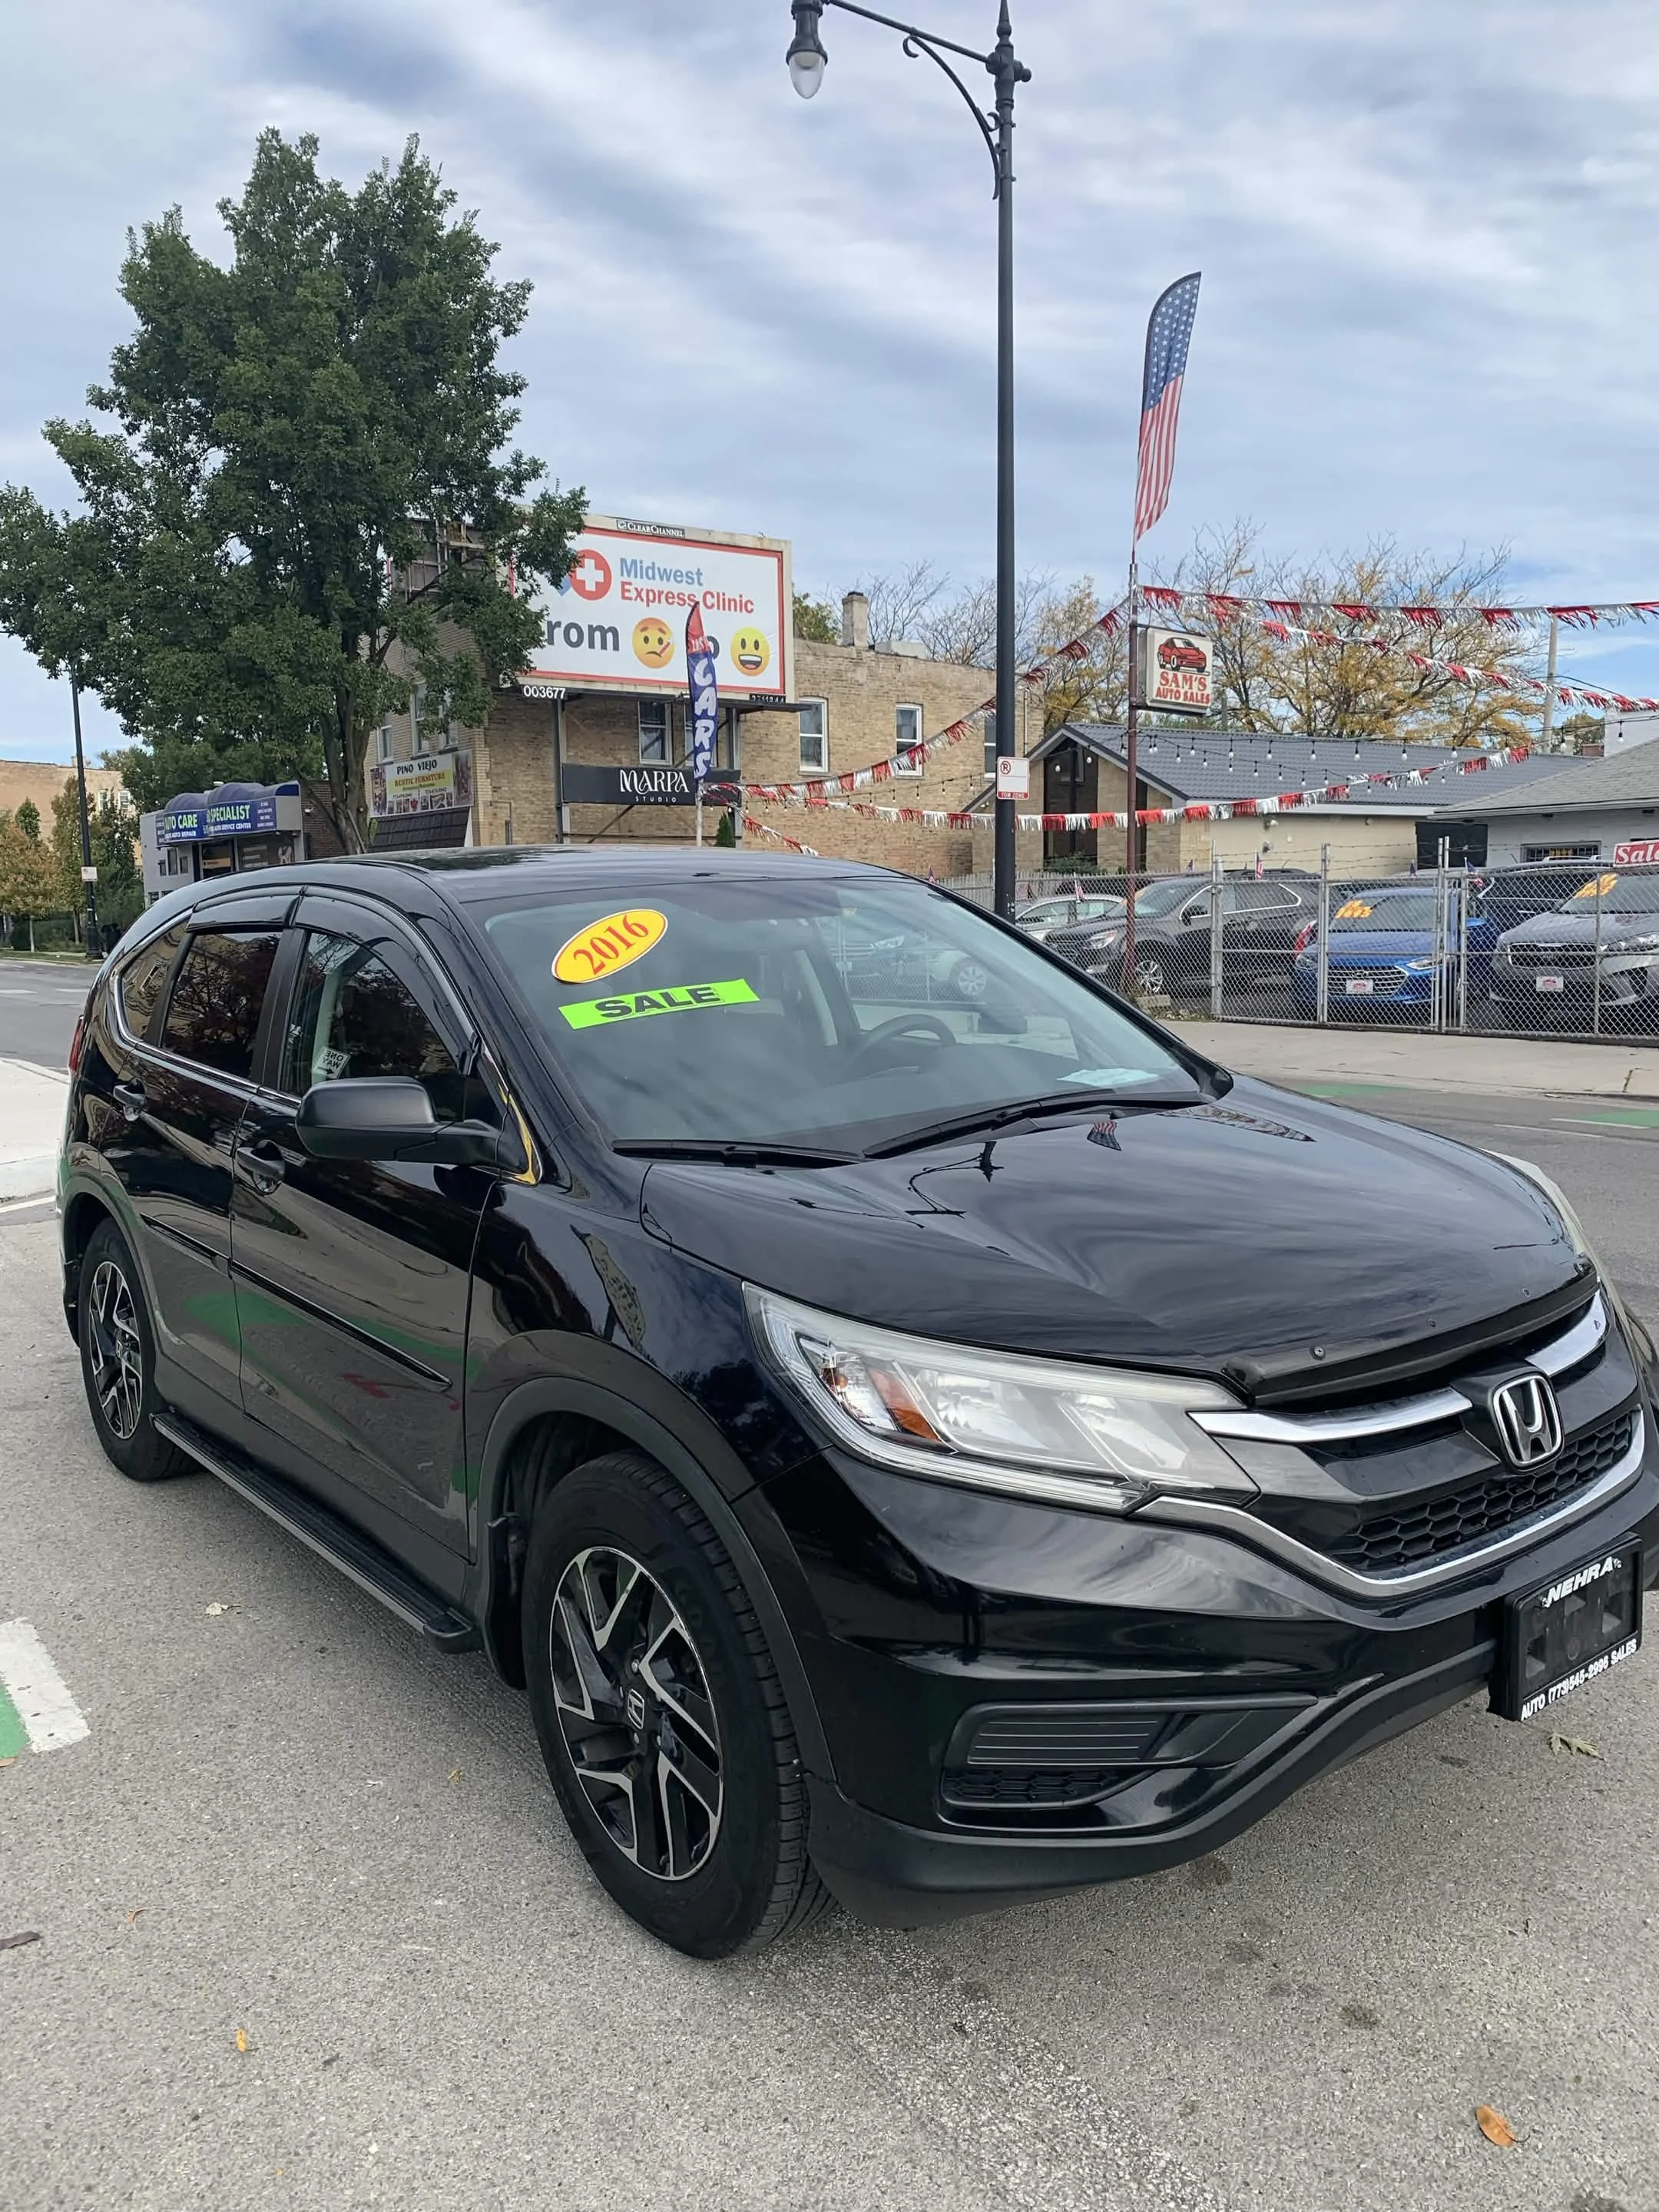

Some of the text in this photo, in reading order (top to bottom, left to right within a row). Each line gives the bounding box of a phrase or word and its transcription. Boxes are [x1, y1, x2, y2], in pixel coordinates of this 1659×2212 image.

[619, 558, 704, 587] Midwest
[620, 581, 754, 614] Express Clinic
[546, 620, 620, 652] rom
[523, 685, 566, 700] 003677
[1155, 687, 1210, 704] AUTO SALES
[1160, 671, 1207, 691] SAM'S
[694, 658, 717, 779] CARS
[396, 759, 438, 774] PINO VIEJO
[619, 770, 690, 795] MARPA
[177, 814, 197, 830] CARE
[210, 804, 250, 823] SPECIALIST
[573, 915, 649, 975] 2016
[594, 986, 721, 1018] SALE
[1545, 1555, 1614, 1606] NEHRA
[1521, 1694, 1546, 1721] AUTO
[1611, 1638, 1637, 1665] SALES
